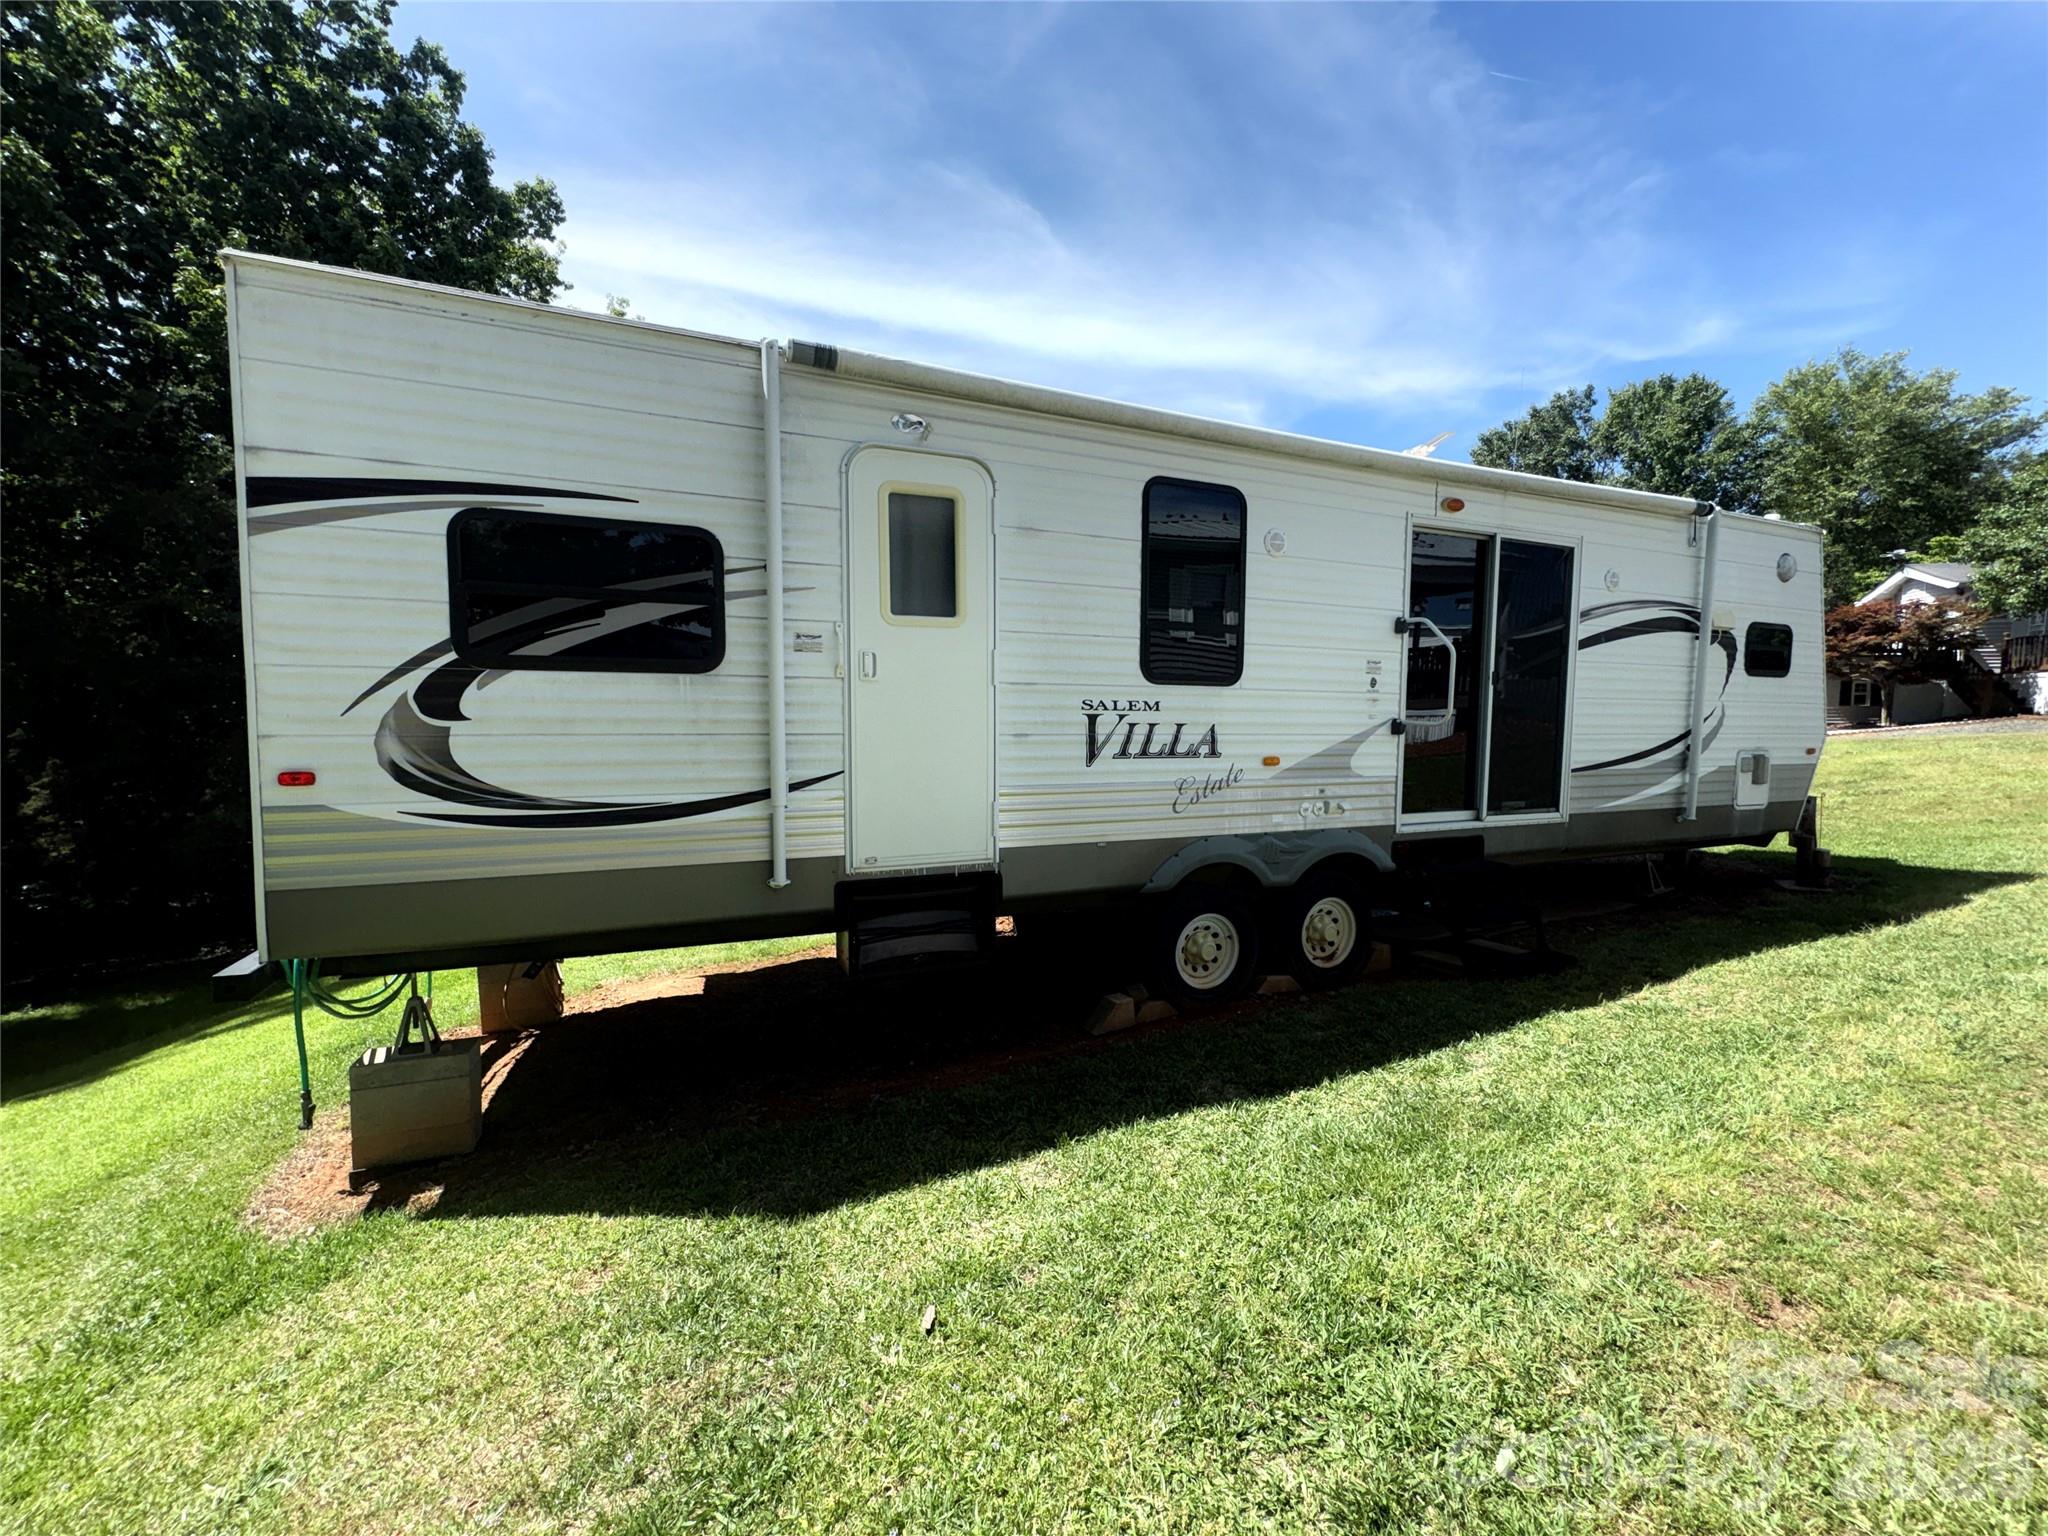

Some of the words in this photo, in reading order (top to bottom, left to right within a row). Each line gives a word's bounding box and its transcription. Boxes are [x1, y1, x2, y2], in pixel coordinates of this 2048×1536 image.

[1081, 699, 1161, 712] SALEM
[1081, 713, 1222, 768] VILLA
[1172, 762, 1246, 814] Estate
